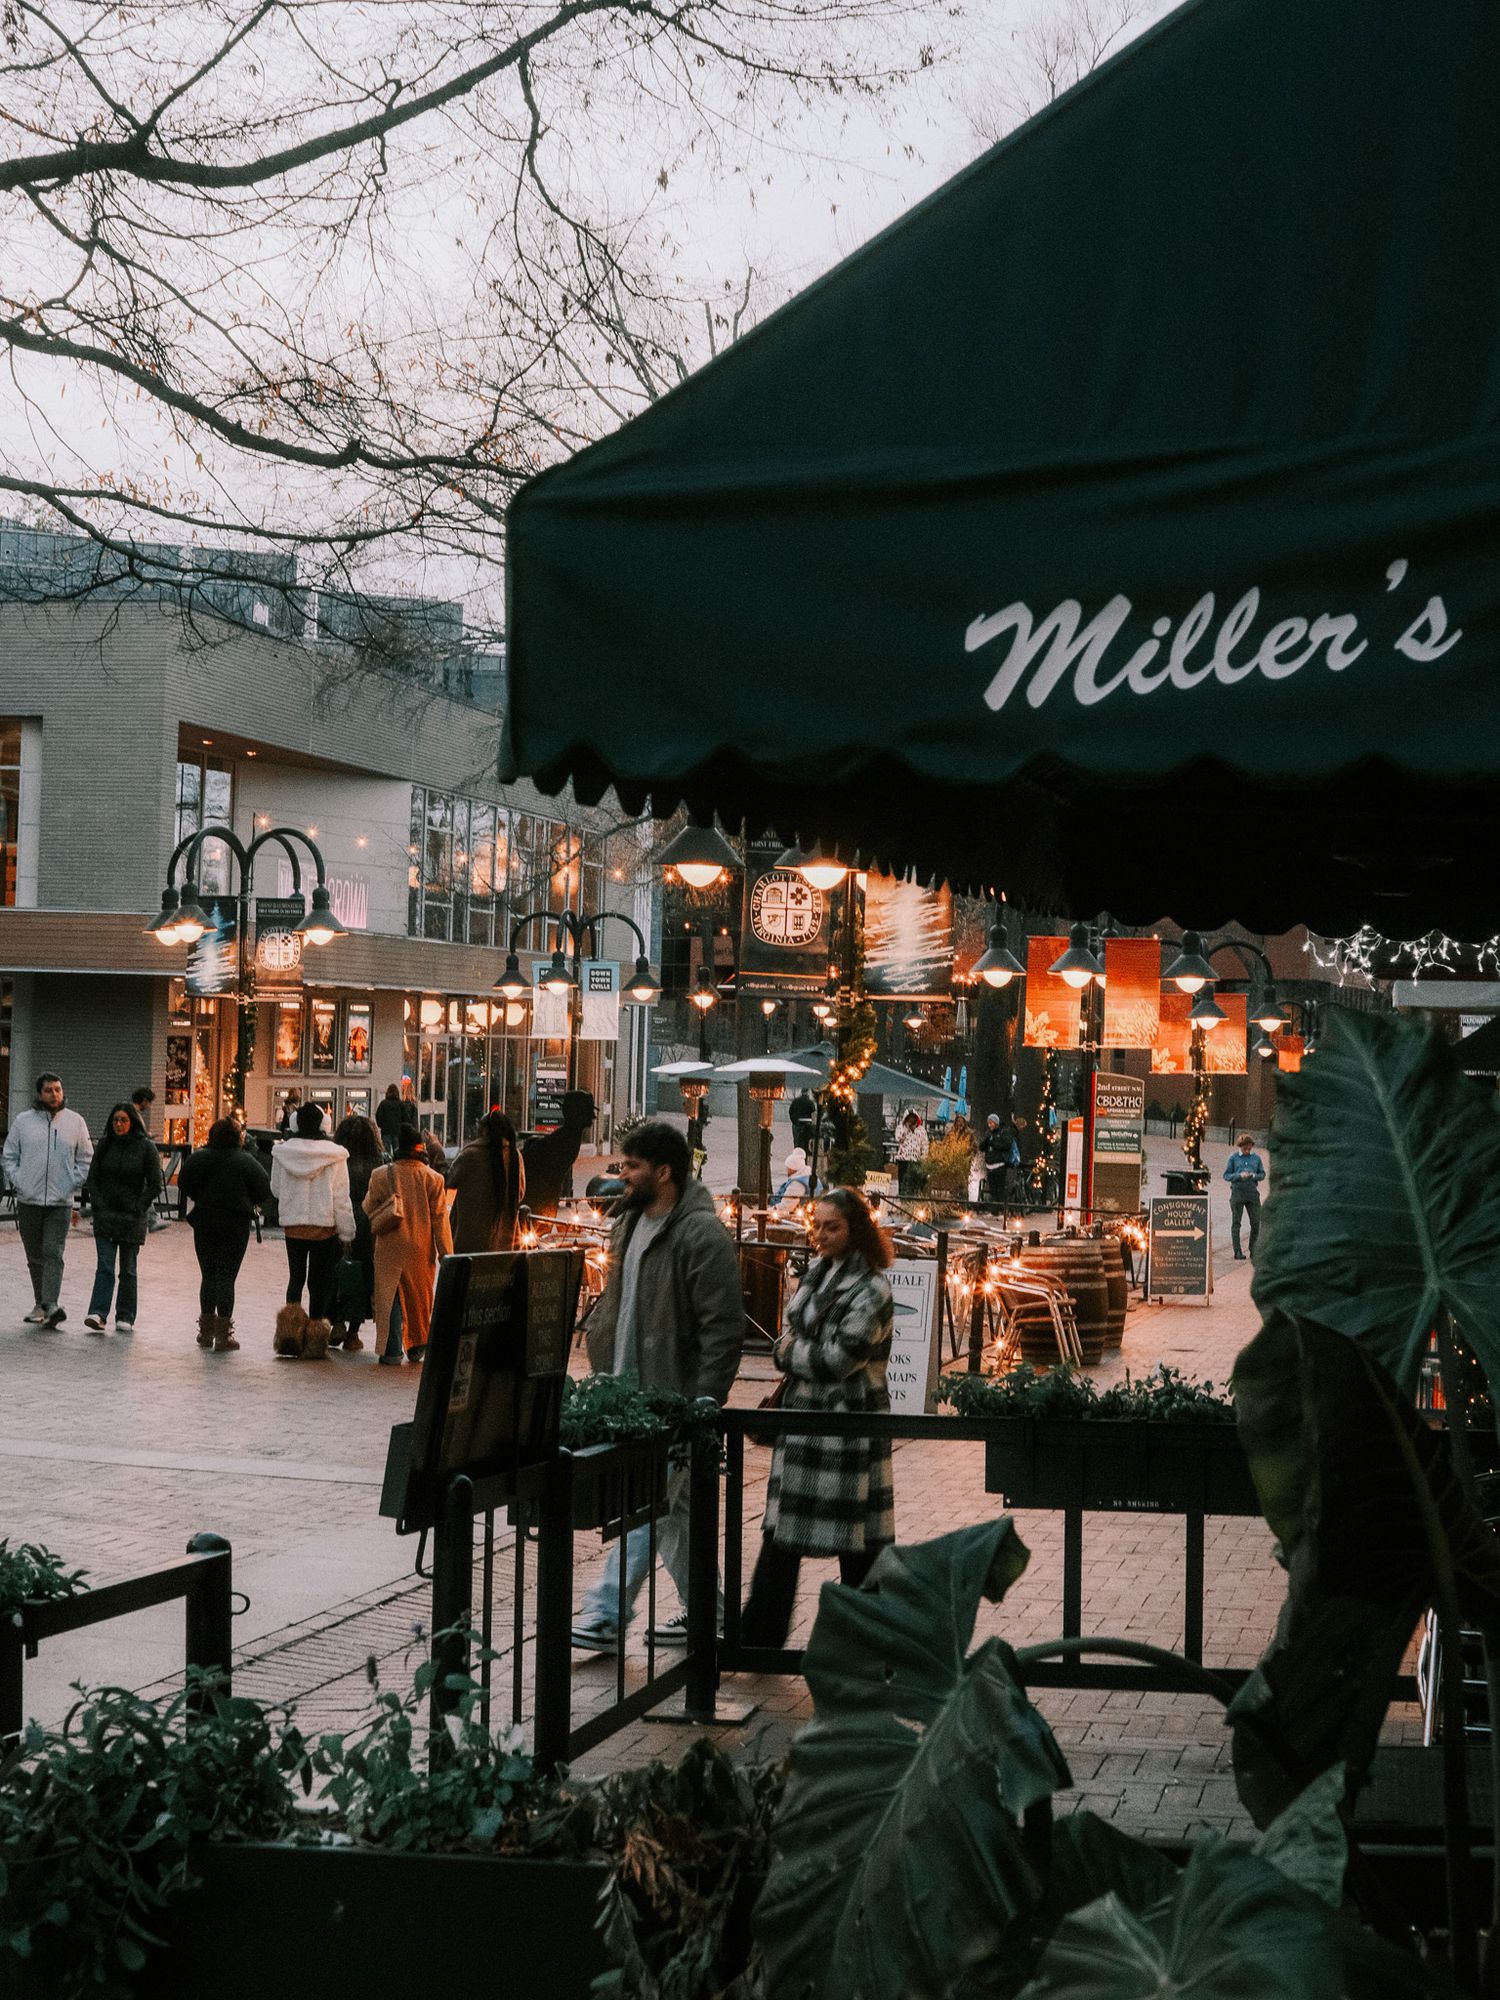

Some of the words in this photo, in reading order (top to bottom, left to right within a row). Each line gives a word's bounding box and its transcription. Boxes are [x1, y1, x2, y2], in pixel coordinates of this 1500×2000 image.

[965, 559, 1462, 711] Miller's
[753, 916, 795, 944] VIRGINIA
[1097, 1083, 1111, 1091] 2nd
[1153, 1200, 1207, 1216] CONSIGNMENT
[1167, 1210, 1192, 1218] HOUSE
[1164, 1218, 1195, 1226] GALLERY
